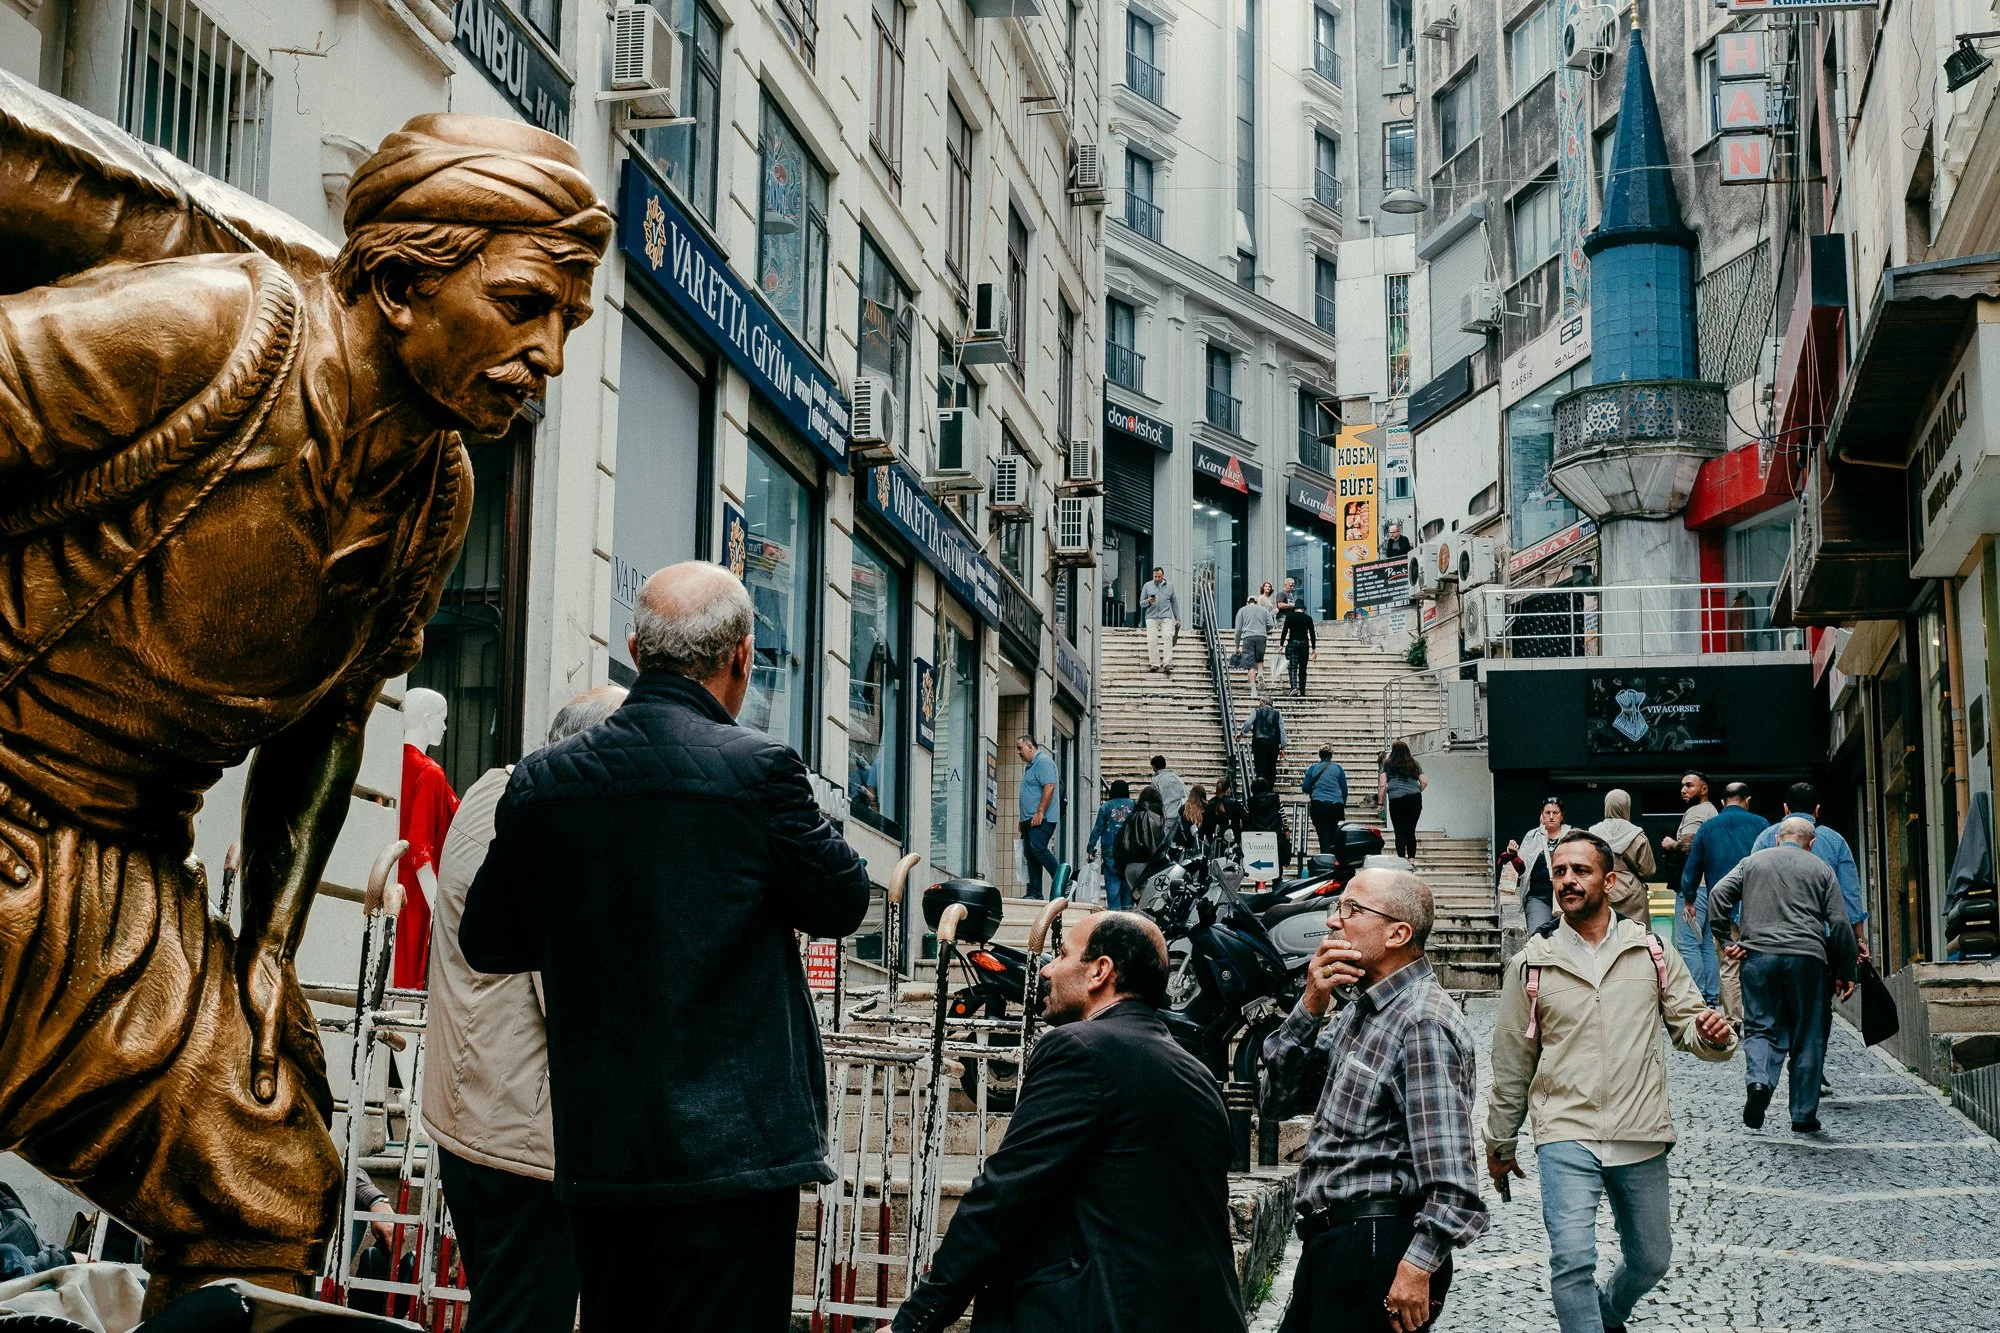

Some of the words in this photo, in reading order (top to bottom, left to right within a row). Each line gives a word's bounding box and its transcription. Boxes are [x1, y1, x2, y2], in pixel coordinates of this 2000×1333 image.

[451, 0, 533, 114] ANBUL
[536, 86, 568, 141] HAN
[1724, 36, 1761, 175] HAN
[670, 221, 749, 357] VARETTA
[750, 323, 792, 401] GİYİM
[1511, 369, 1533, 390] CASSIS
[1340, 473, 1374, 497] BÜFE
[891, 470, 940, 558] VARETTA
[940, 528, 966, 584] GİYİM
[1510, 531, 1576, 571] BENAY
[1646, 704, 1701, 714] VIVACORSET
